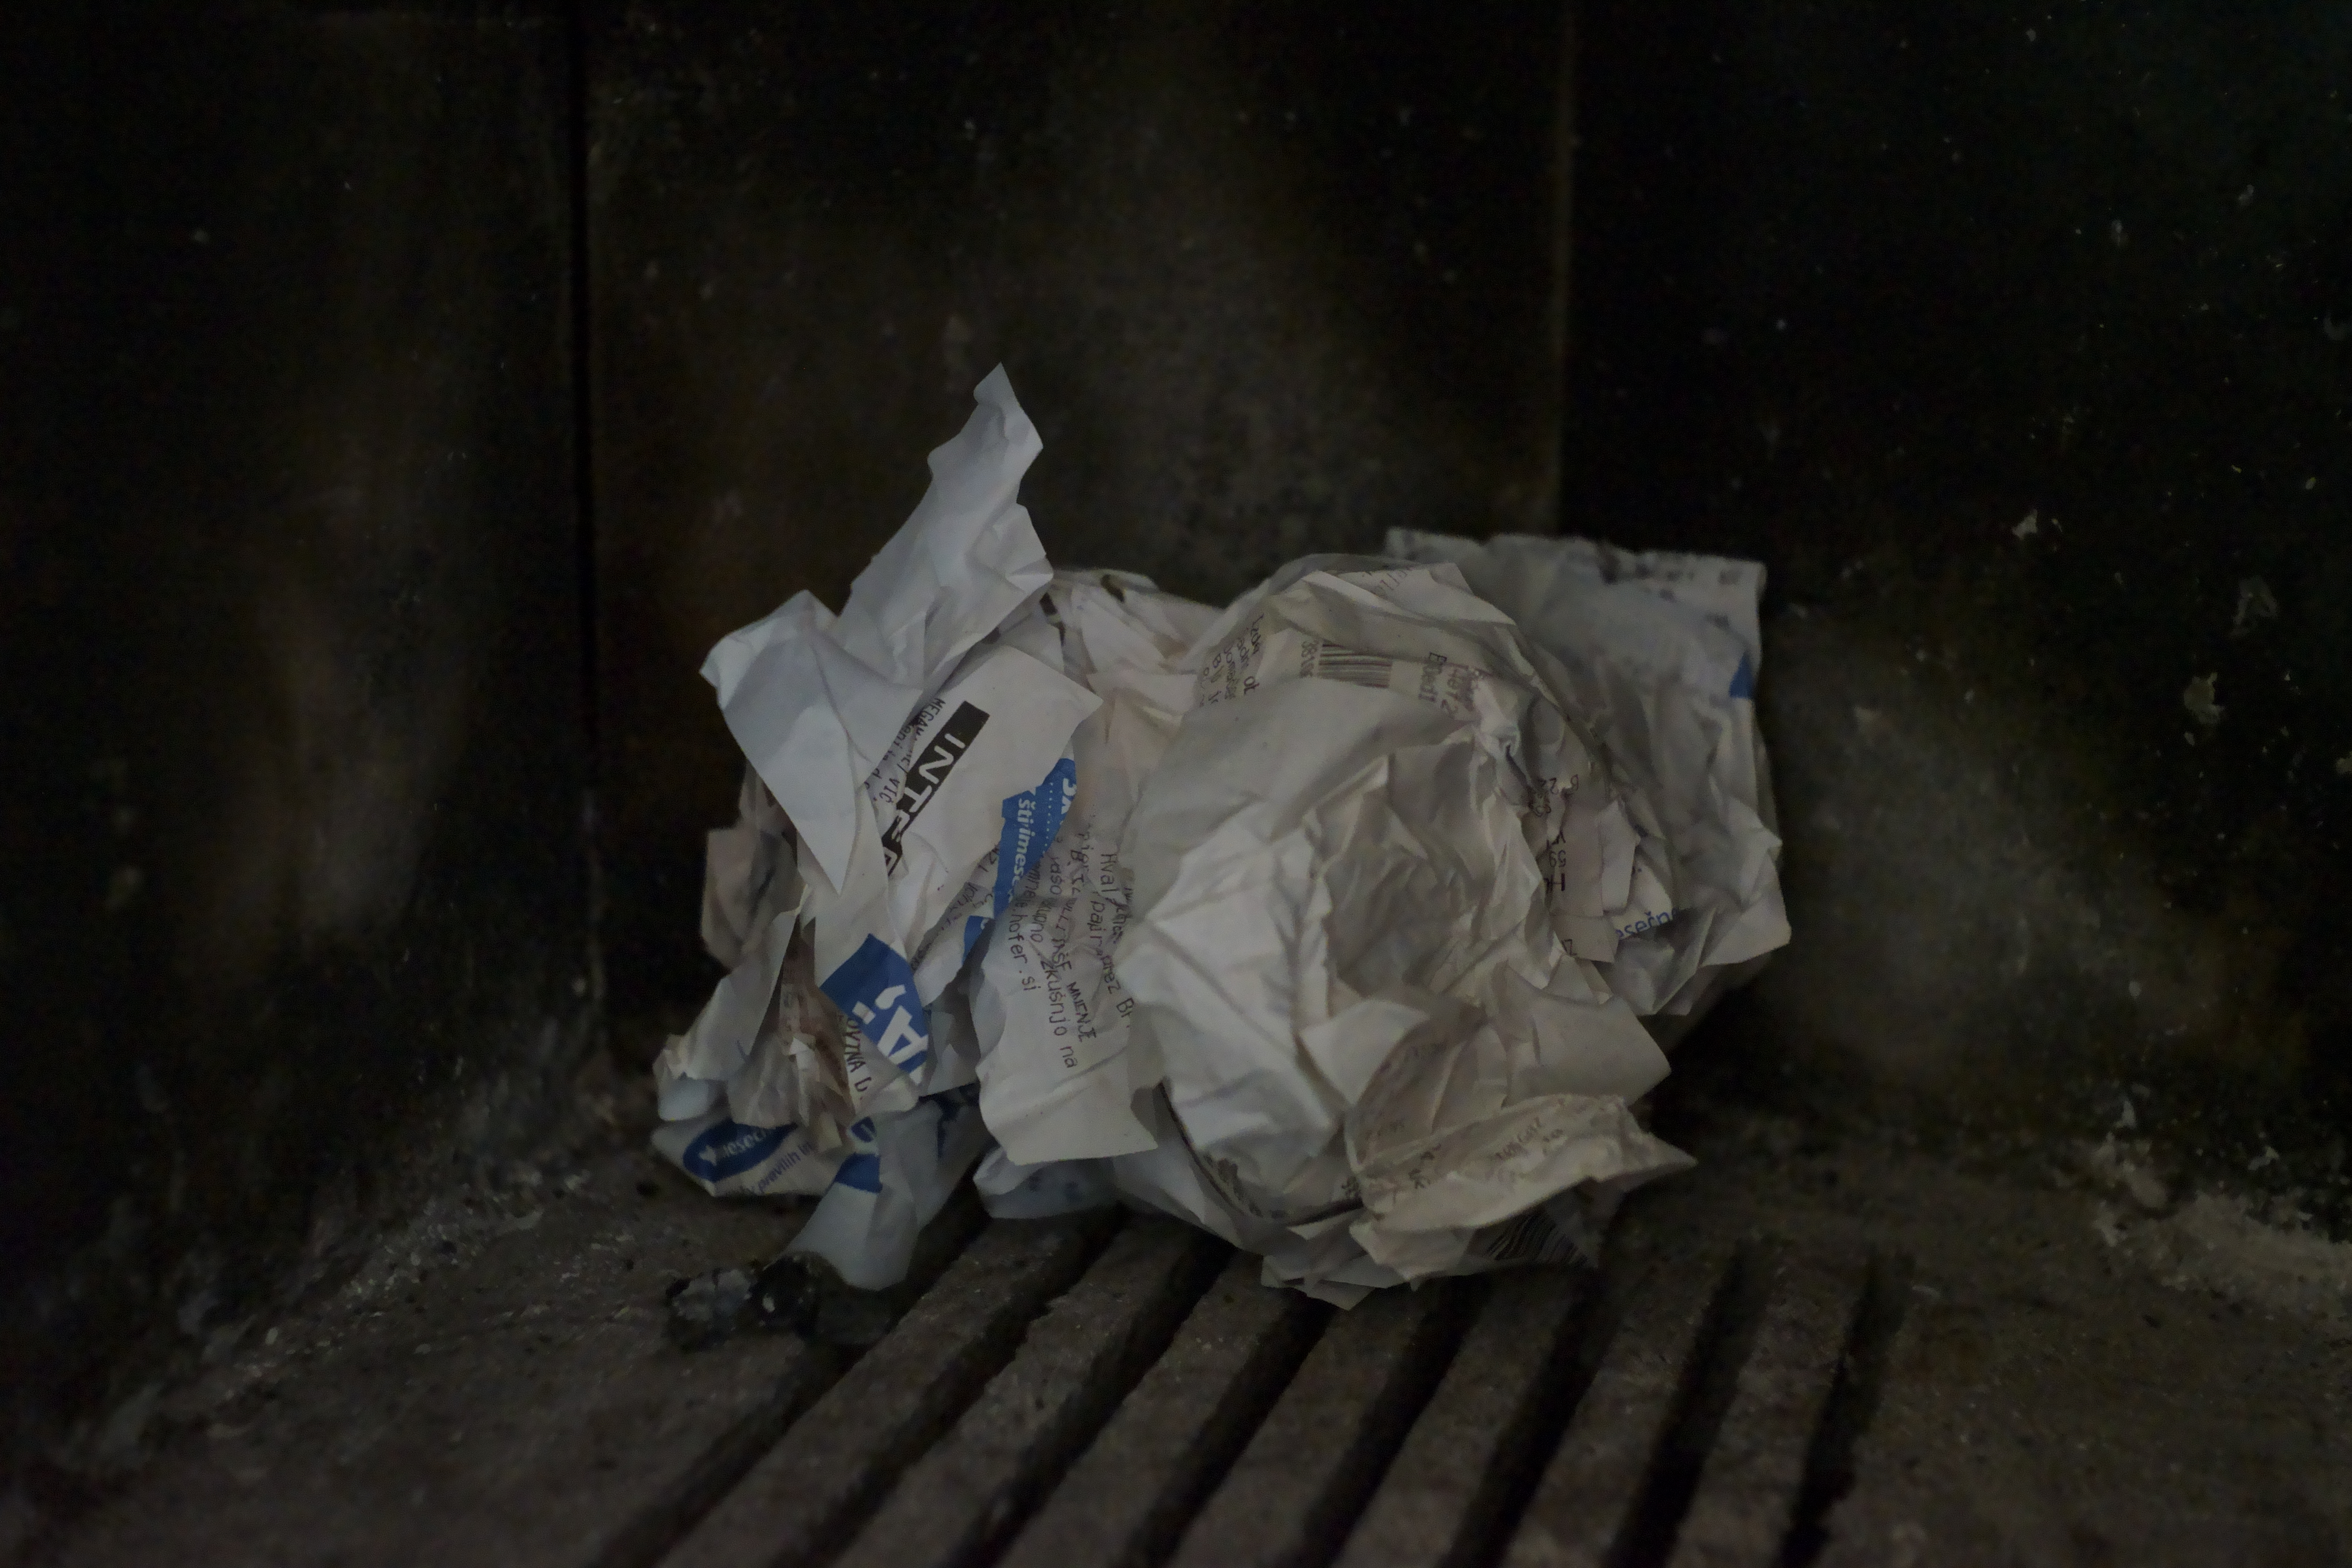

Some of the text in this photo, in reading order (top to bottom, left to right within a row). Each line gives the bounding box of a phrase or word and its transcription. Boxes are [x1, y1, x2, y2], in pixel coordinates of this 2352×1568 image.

[1099, 853, 1120, 893] Hval
[1040, 960, 1069, 1037] zkušnjo
[1059, 1044, 1078, 1069] na
